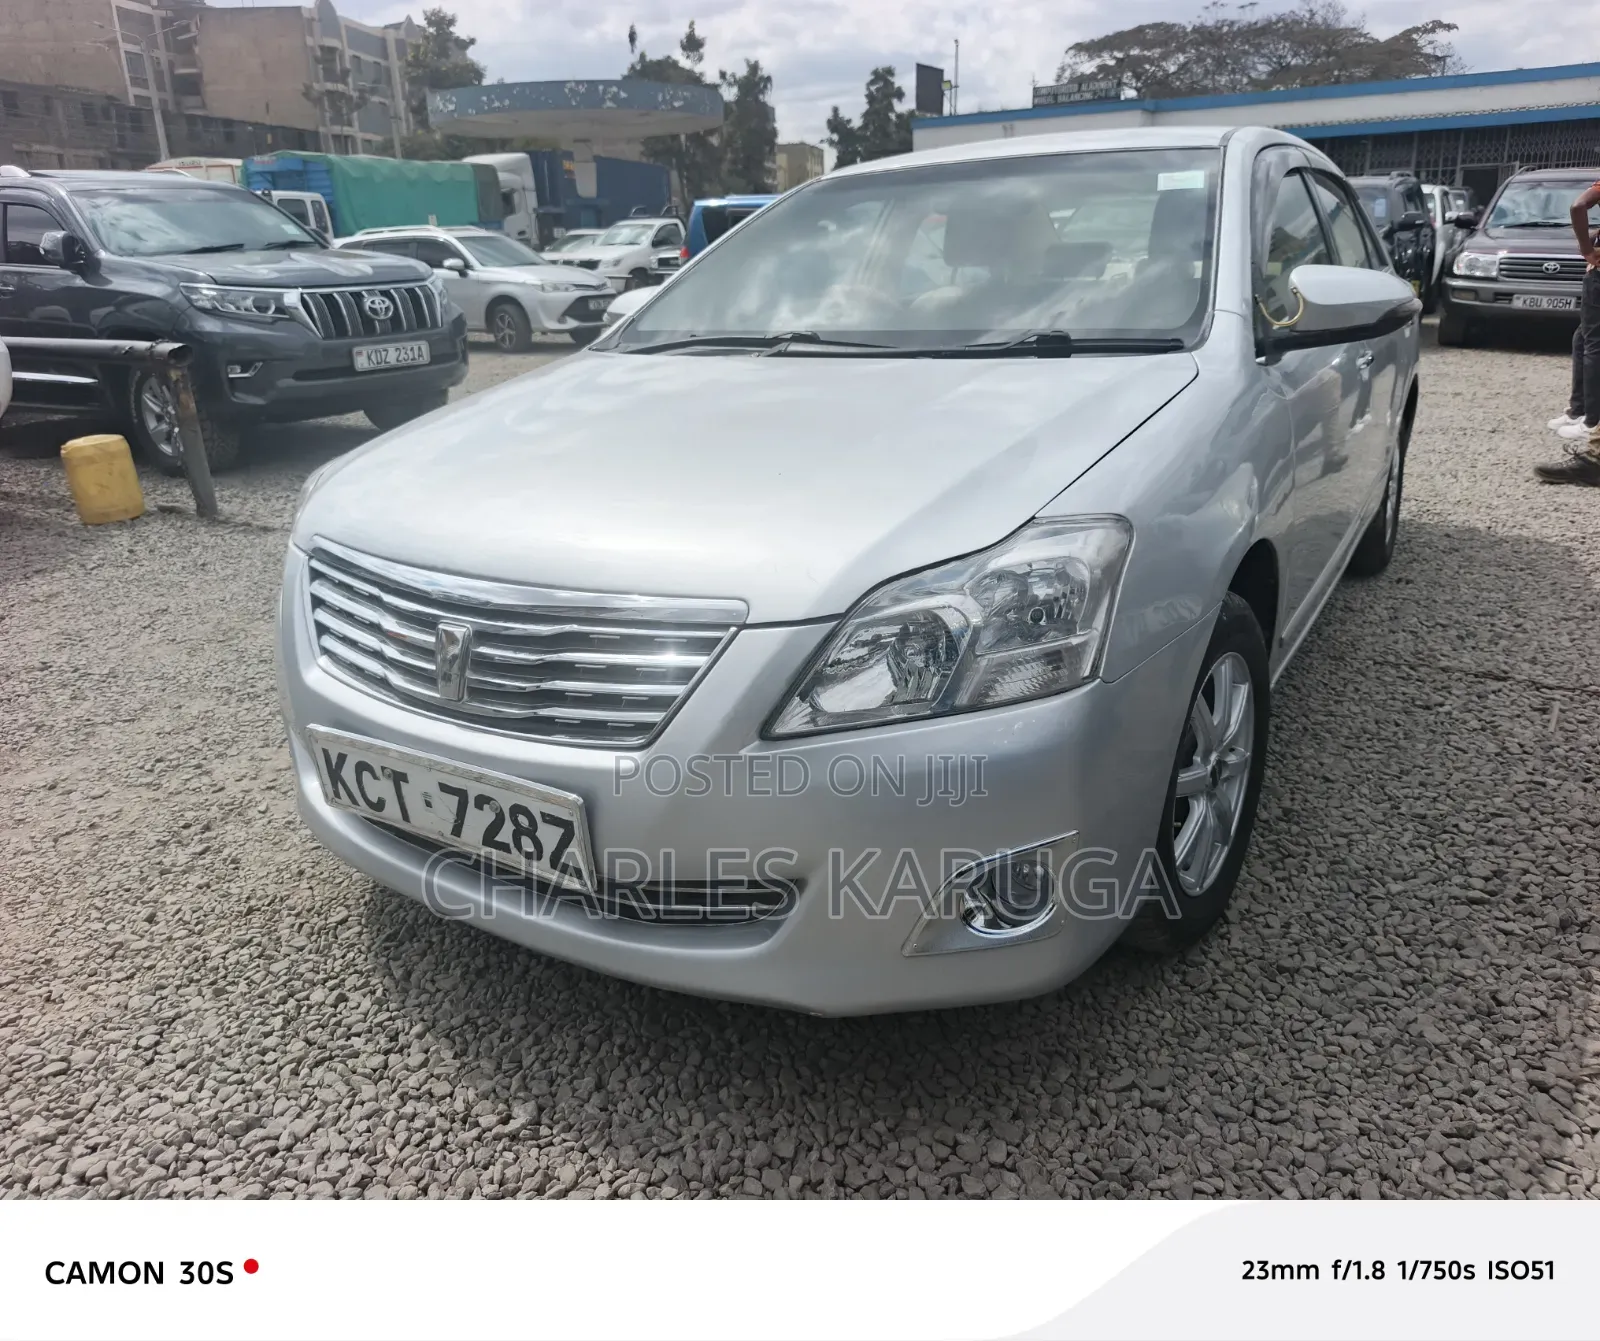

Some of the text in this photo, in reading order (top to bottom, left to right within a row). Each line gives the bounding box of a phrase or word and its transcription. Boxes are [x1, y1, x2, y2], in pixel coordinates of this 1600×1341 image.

[1523, 296, 1572, 309] KBU 905H
[367, 346, 425, 366] KDZ 231A
[322, 748, 586, 885] KCT 728Z
